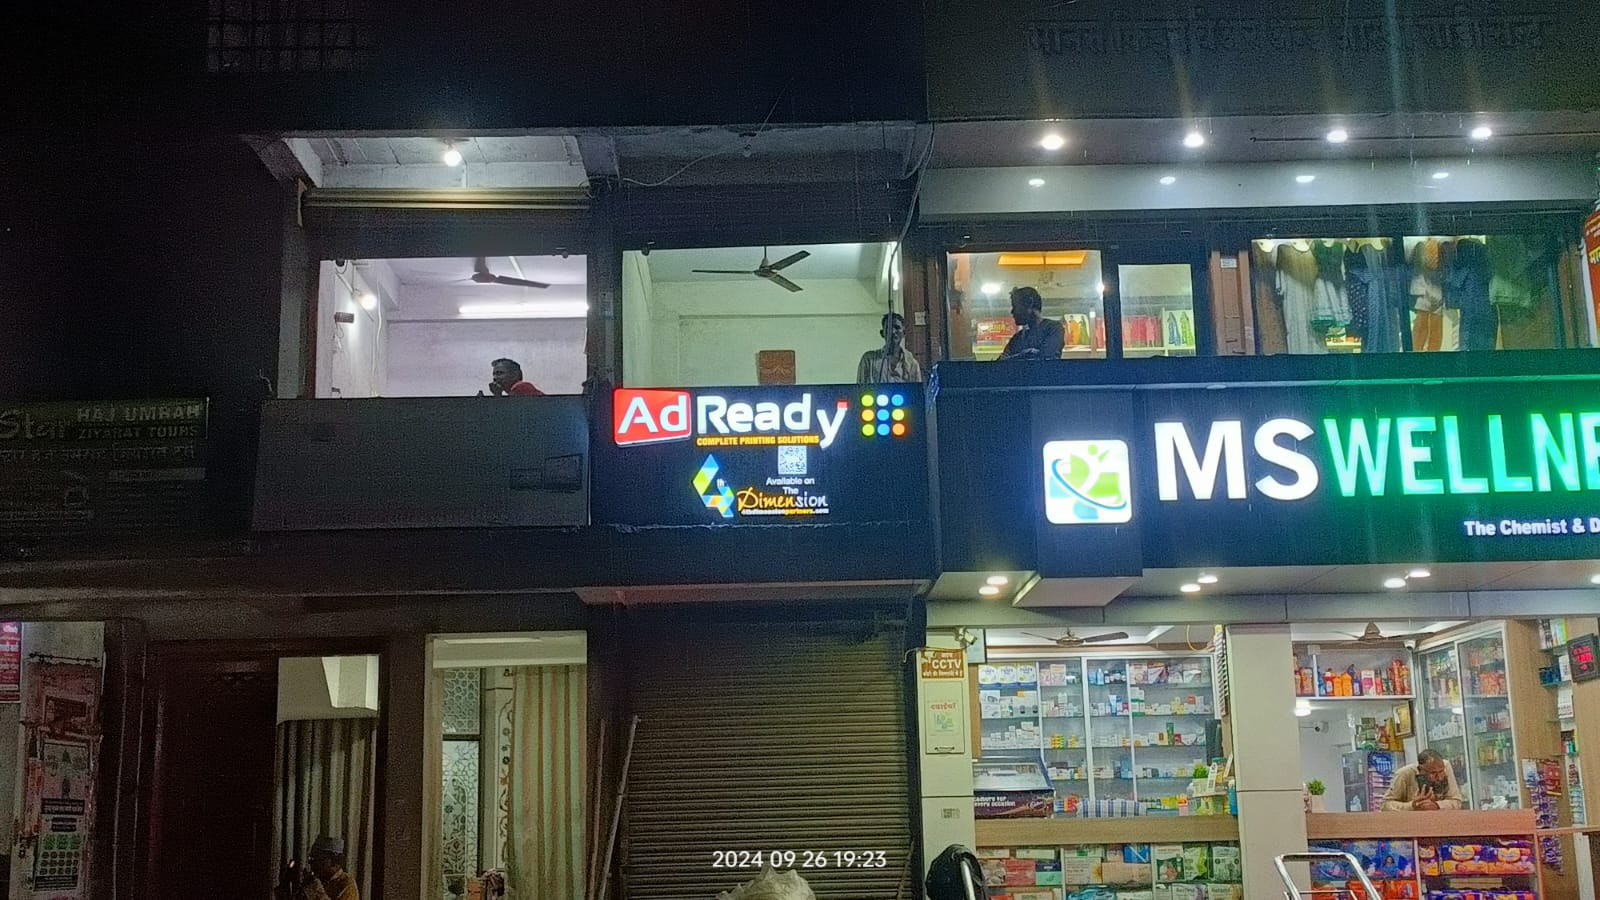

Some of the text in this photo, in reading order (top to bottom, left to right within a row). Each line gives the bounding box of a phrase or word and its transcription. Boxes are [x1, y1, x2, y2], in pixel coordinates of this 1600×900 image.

[617, 393, 848, 449] Ad Ready
[696, 435, 819, 446] COMPLETE PRINTING SOLUTIONS
[1154, 418, 1319, 500] MS
[765, 477, 803, 486] Available
[783, 486, 799, 494] The
[736, 487, 828, 511] Dimension
[1463, 520, 1497, 536] The
[1500, 518, 1568, 535] Chemist
[1571, 517, 1586, 534] &
[931, 659, 962, 670] CCTV
